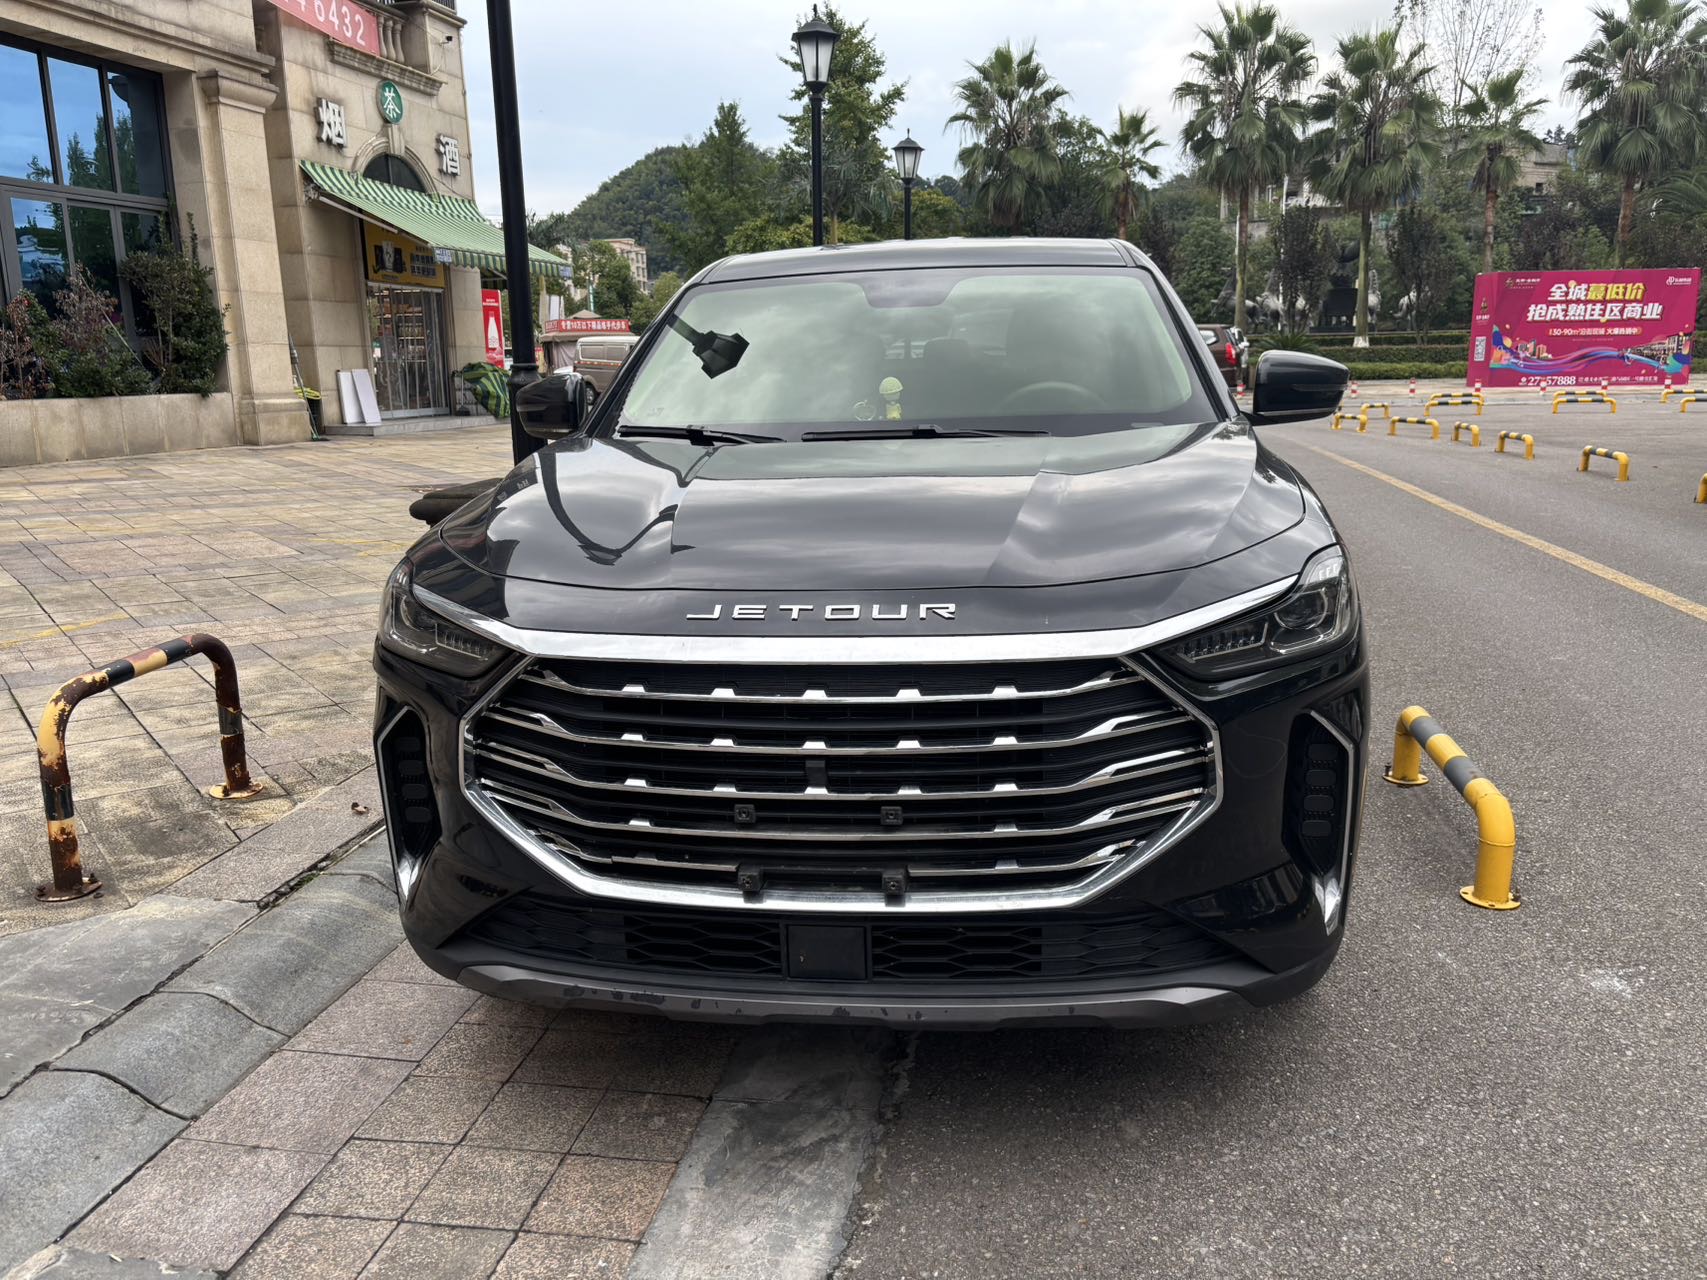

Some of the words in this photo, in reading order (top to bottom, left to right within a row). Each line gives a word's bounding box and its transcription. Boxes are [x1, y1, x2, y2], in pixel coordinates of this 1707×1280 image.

[382, 87, 401, 117] 茶
[317, 98, 347, 147] 烟
[438, 134, 461, 176] 酒
[1547, 283, 1646, 301] 全城最低价
[1527, 303, 1663, 321] 抢成熟住区商业
[1527, 375, 1576, 386] 2757888
[686, 603, 956, 620] JETOUR
